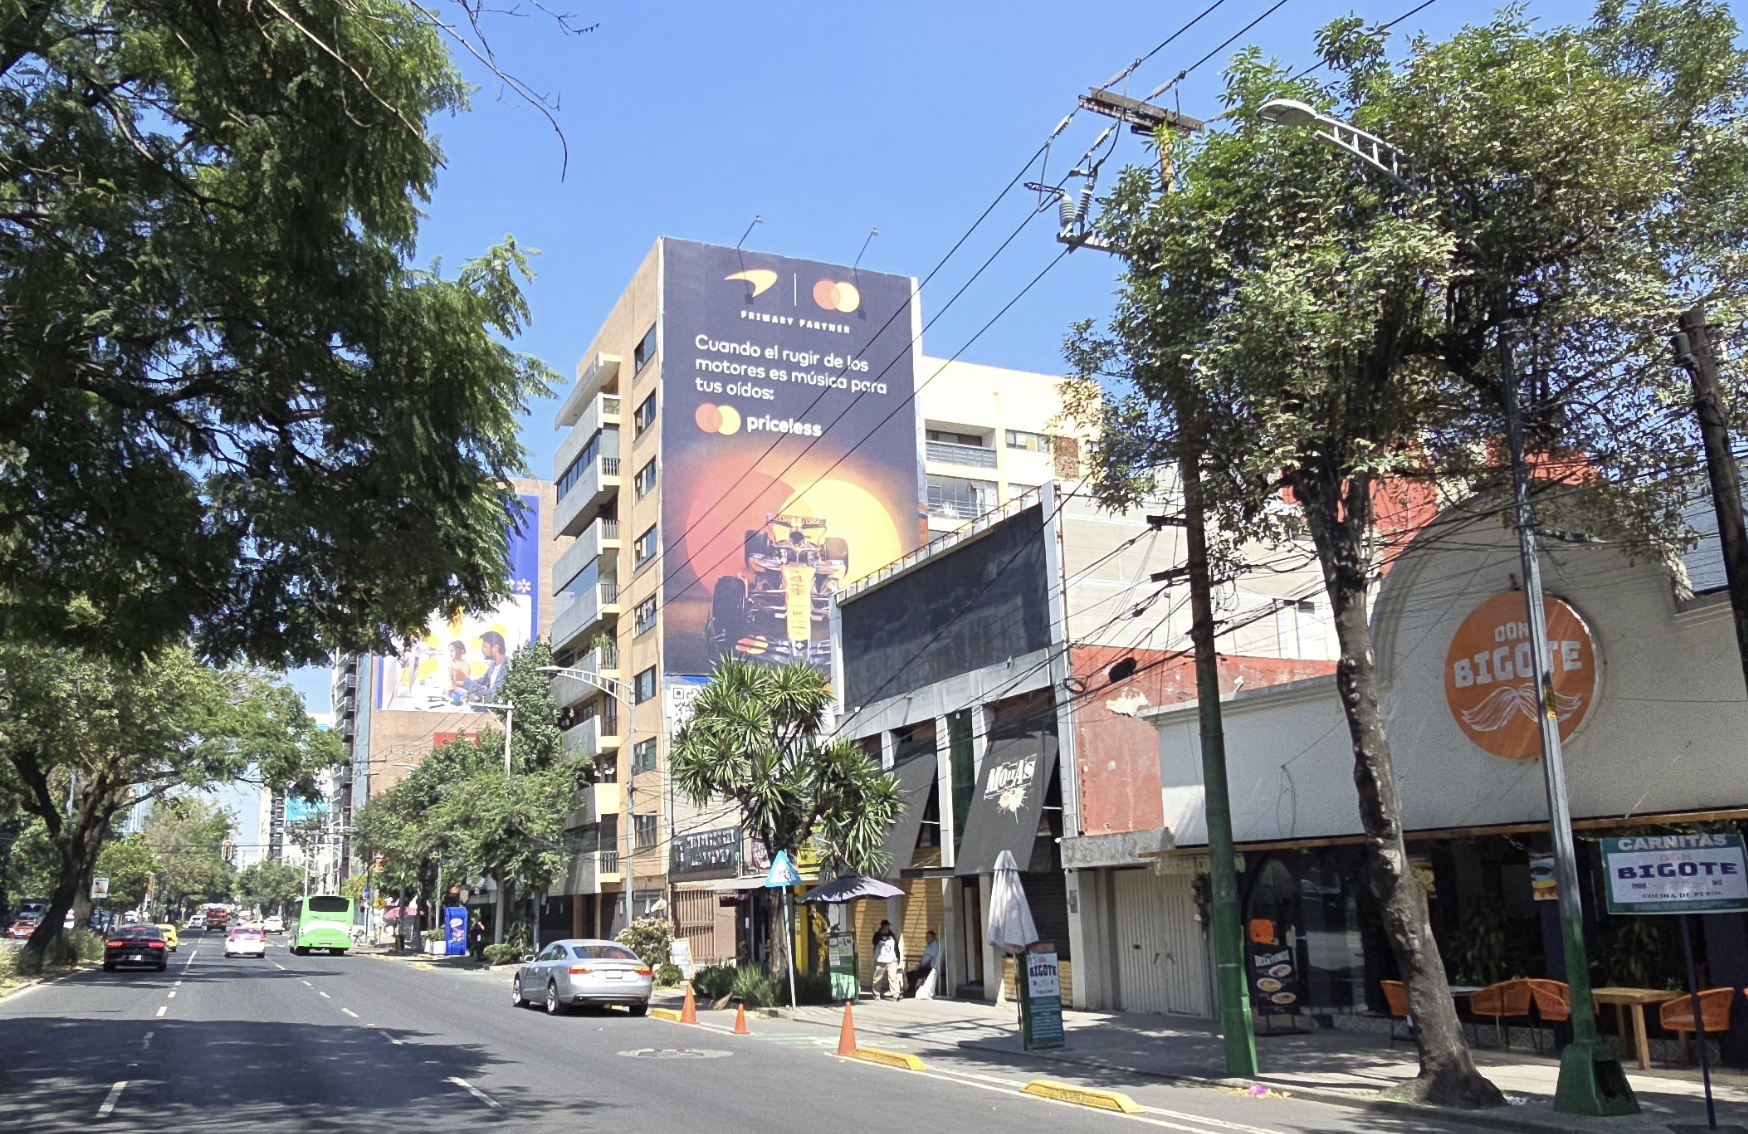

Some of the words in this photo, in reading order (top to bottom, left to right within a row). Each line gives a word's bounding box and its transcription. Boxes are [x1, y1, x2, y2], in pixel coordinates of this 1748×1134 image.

[740, 310, 794, 326] PRIMARY
[799, 319, 851, 334] PARTNER
[695, 334, 761, 358] Cuando
[764, 345, 779, 360] el
[782, 350, 820, 367] rugir
[824, 353, 844, 369] de
[847, 355, 869, 372] los
[695, 358, 766, 379] motores
[769, 369, 788, 382] es
[791, 370, 847, 389] música
[851, 379, 888, 395] para
[695, 377, 723, 394] tus
[746, 413, 823, 437] priceless
[1618, 834, 1728, 851] CARNITAS
[1617, 861, 1738, 880] BIGOTE
[1029, 963, 1057, 978] BIGOTE
